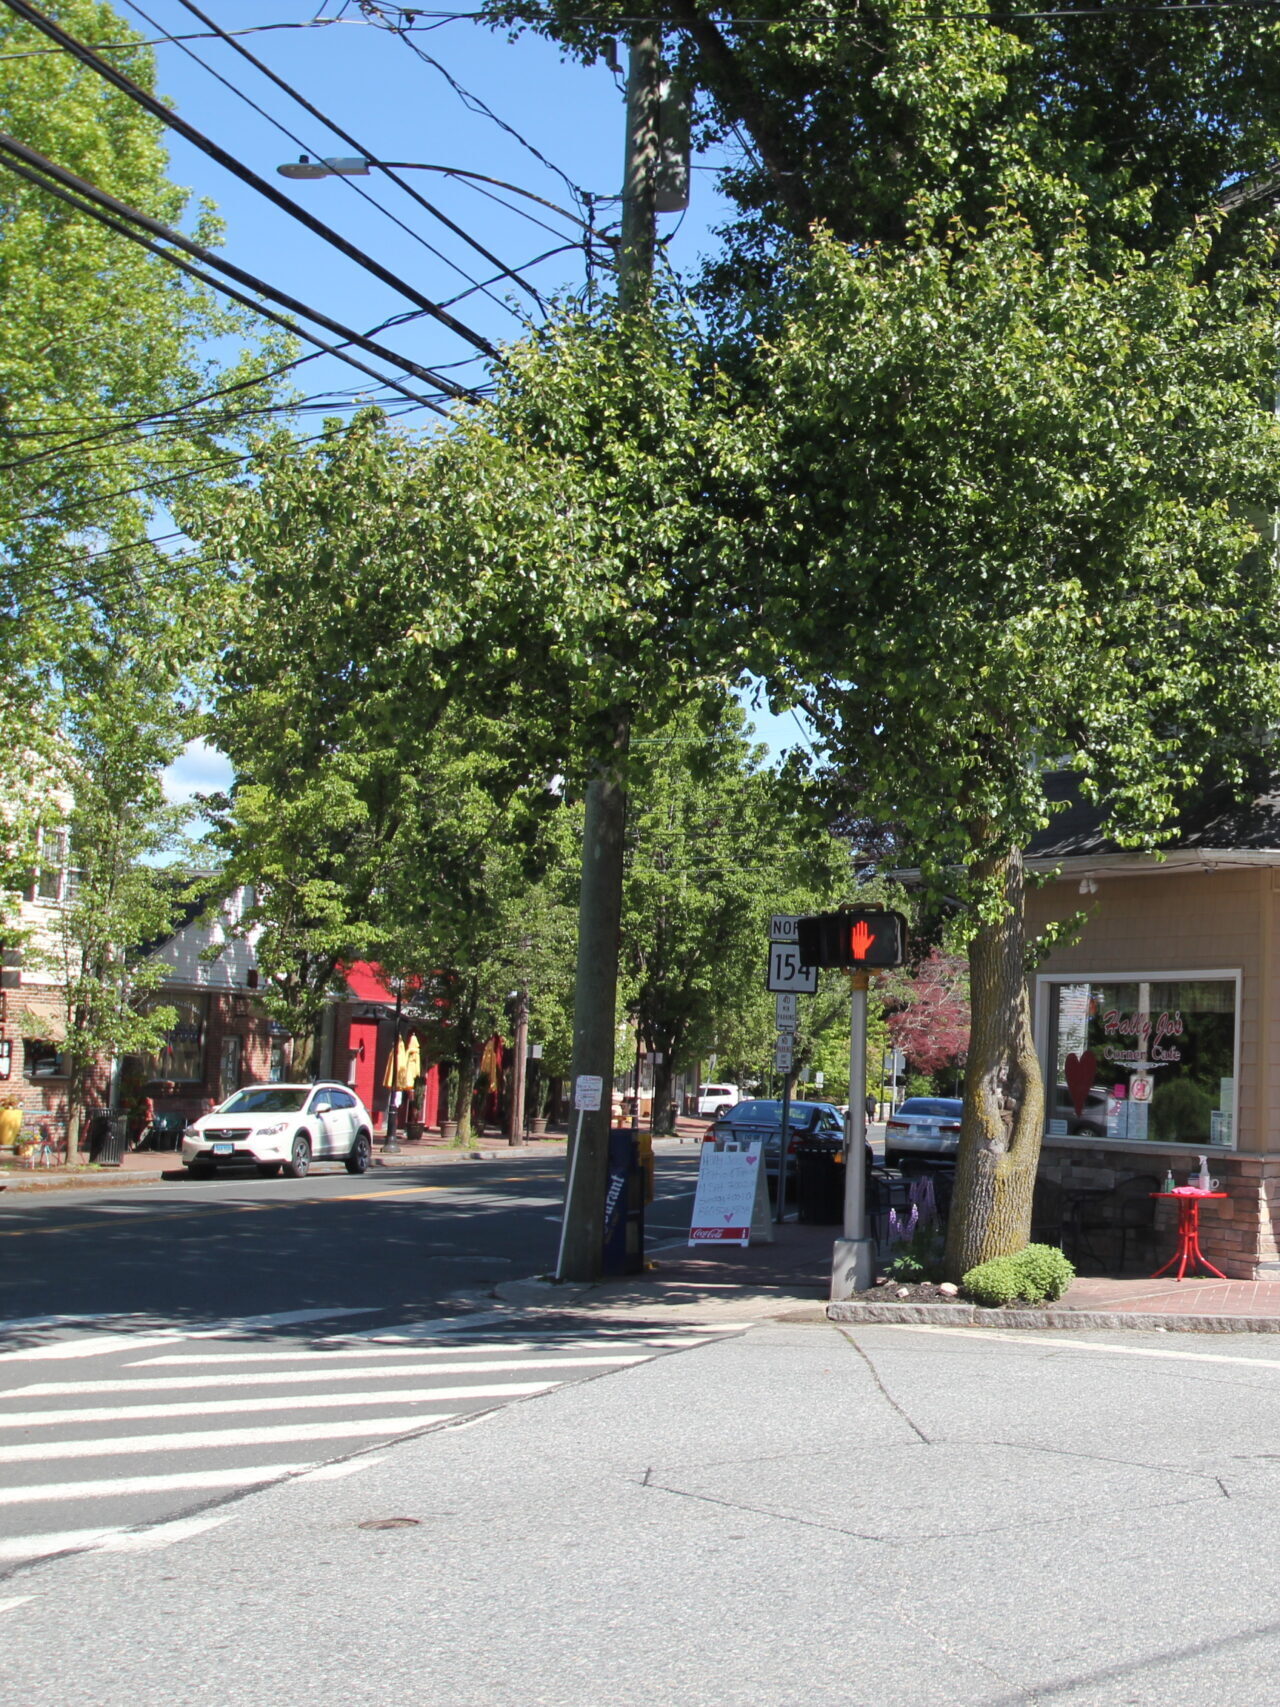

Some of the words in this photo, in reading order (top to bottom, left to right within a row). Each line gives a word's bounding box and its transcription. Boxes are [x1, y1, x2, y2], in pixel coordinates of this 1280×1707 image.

[773, 921, 799, 935] NOR
[776, 954, 811, 981] 154
[1103, 1009, 1152, 1042] Hally
[1154, 1011, 1183, 1046] Jo's
[1104, 1045, 1147, 1060] Corner
[1152, 1045, 1181, 1061] Cafe
[604, 1174, 625, 1233] urant
